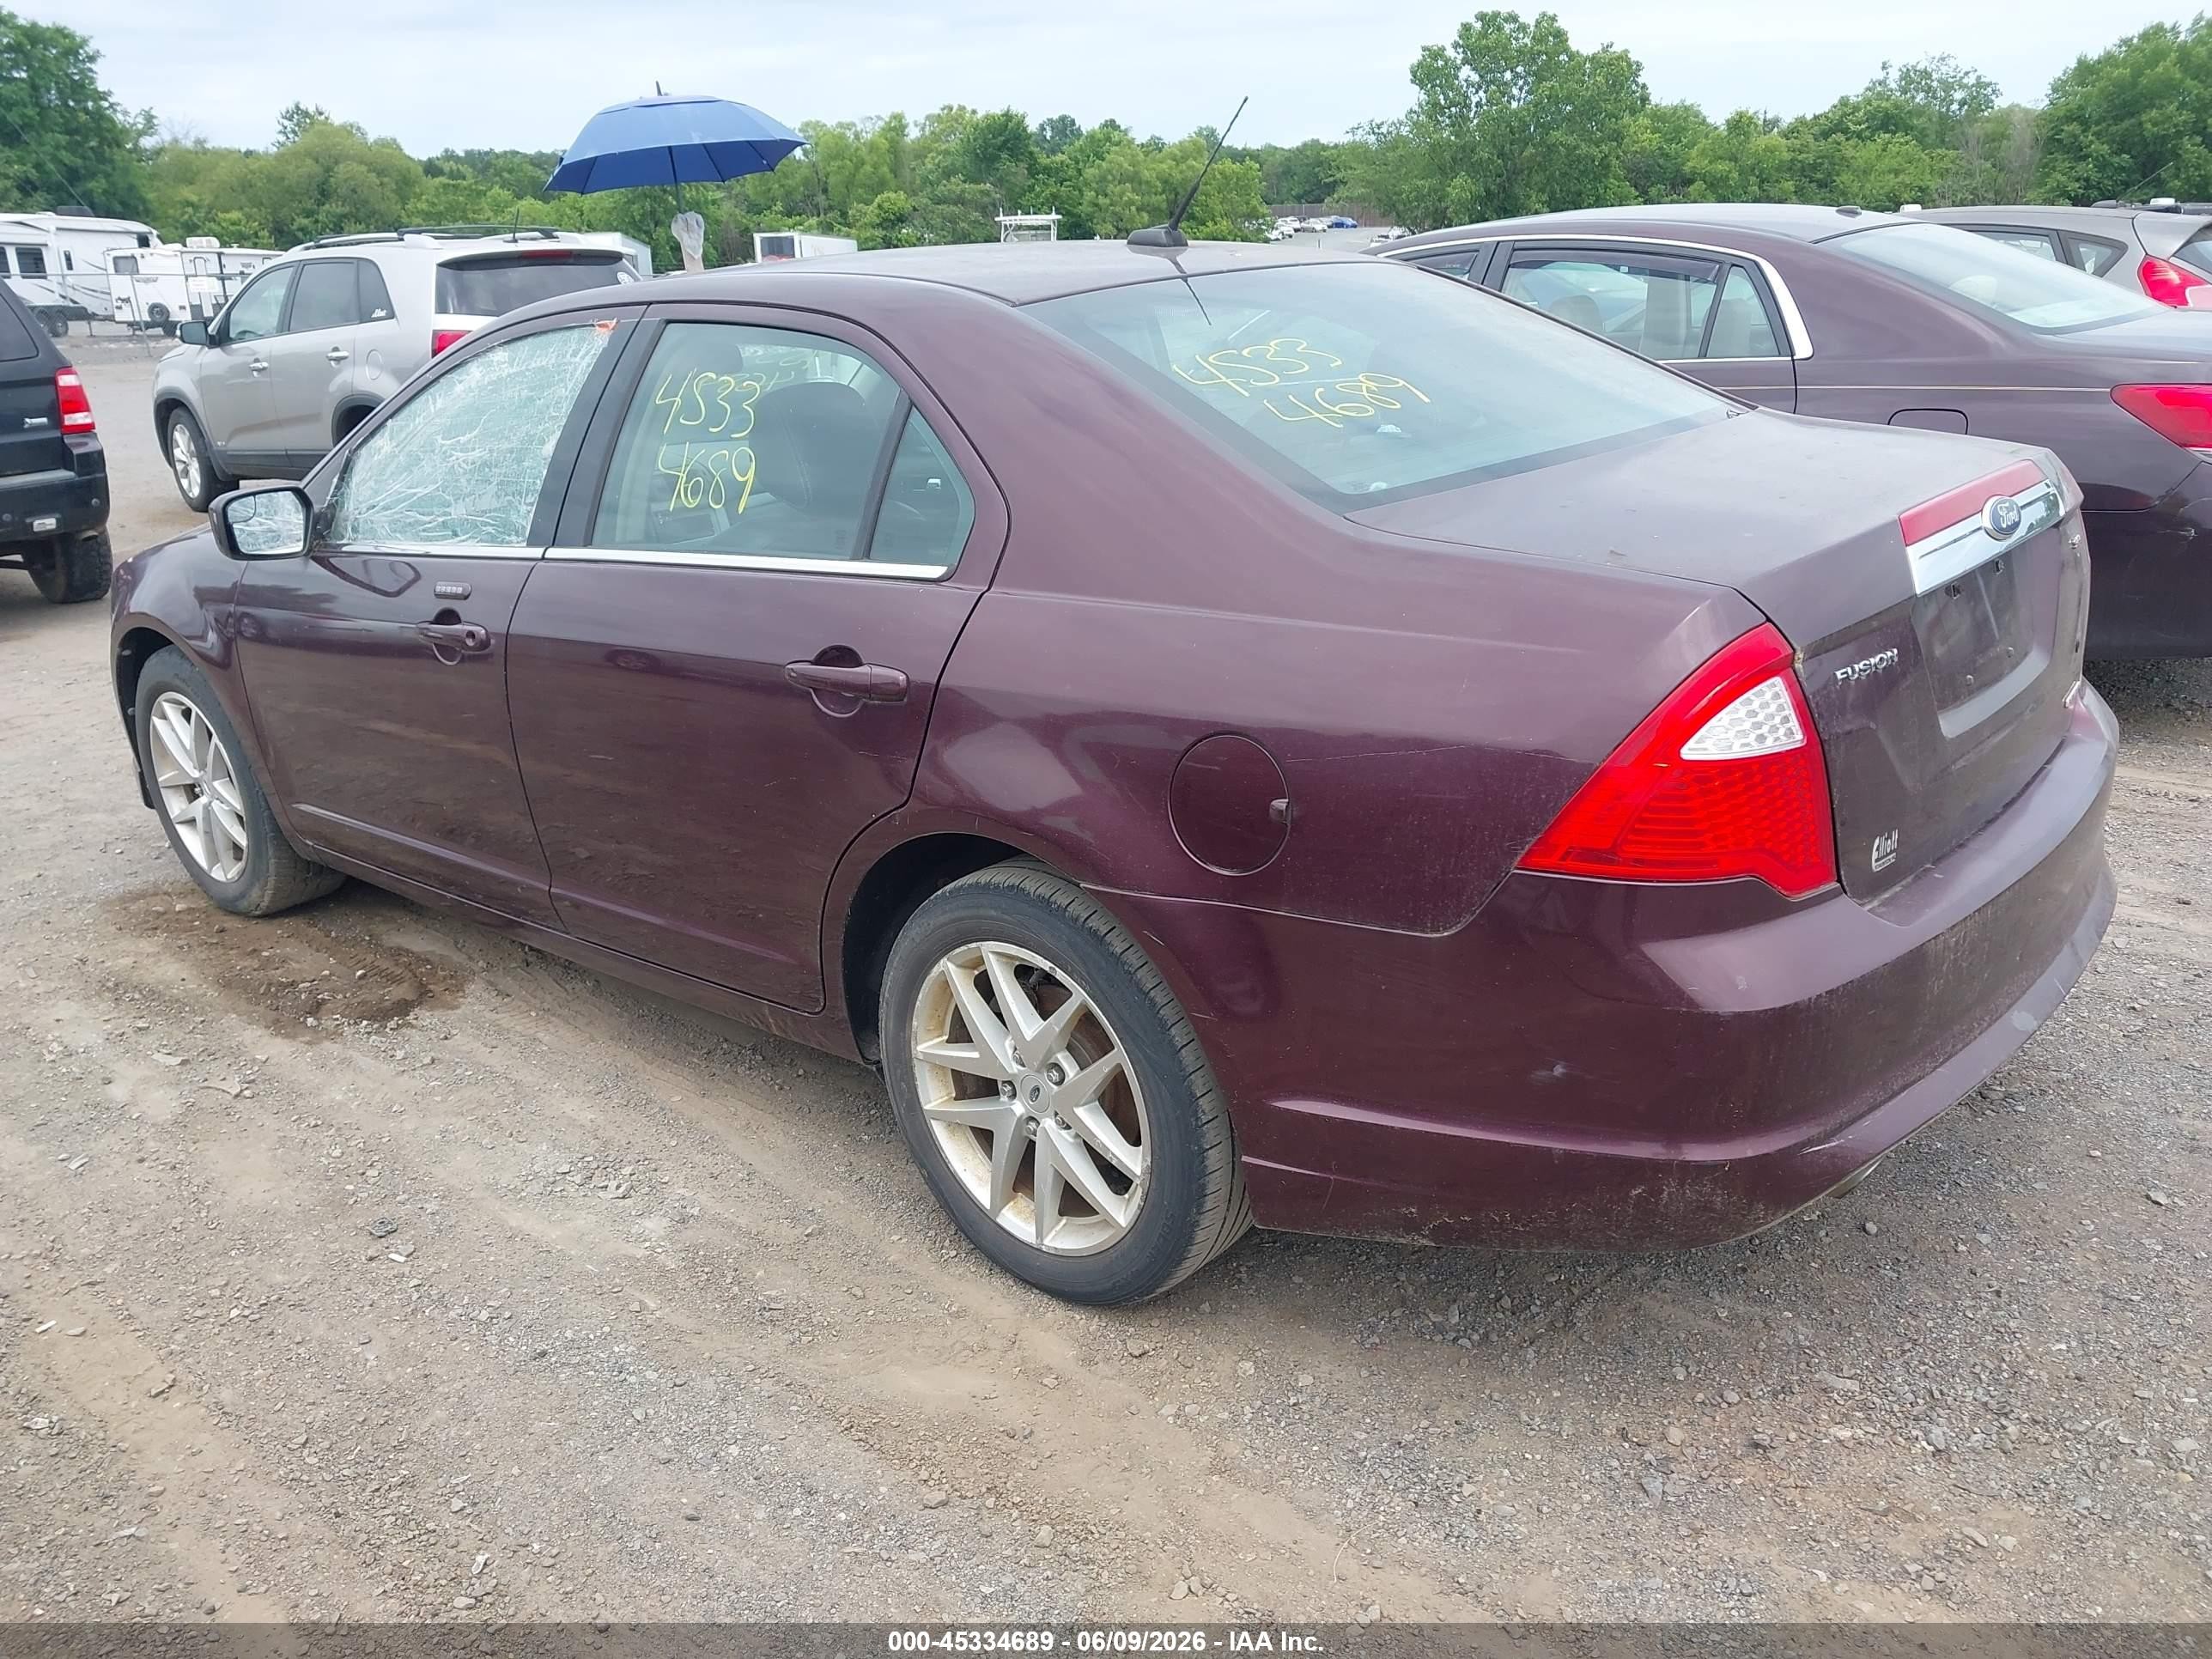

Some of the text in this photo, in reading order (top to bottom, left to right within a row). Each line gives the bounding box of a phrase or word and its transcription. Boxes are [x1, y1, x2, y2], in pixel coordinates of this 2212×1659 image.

[1173, 338, 1342, 397] 4533
[655, 368, 760, 438] 4533
[1263, 373, 1431, 427] 4689
[658, 441, 756, 514] 4689
[1996, 501, 2019, 528] Ford
[1834, 648, 1898, 685] FUSION
